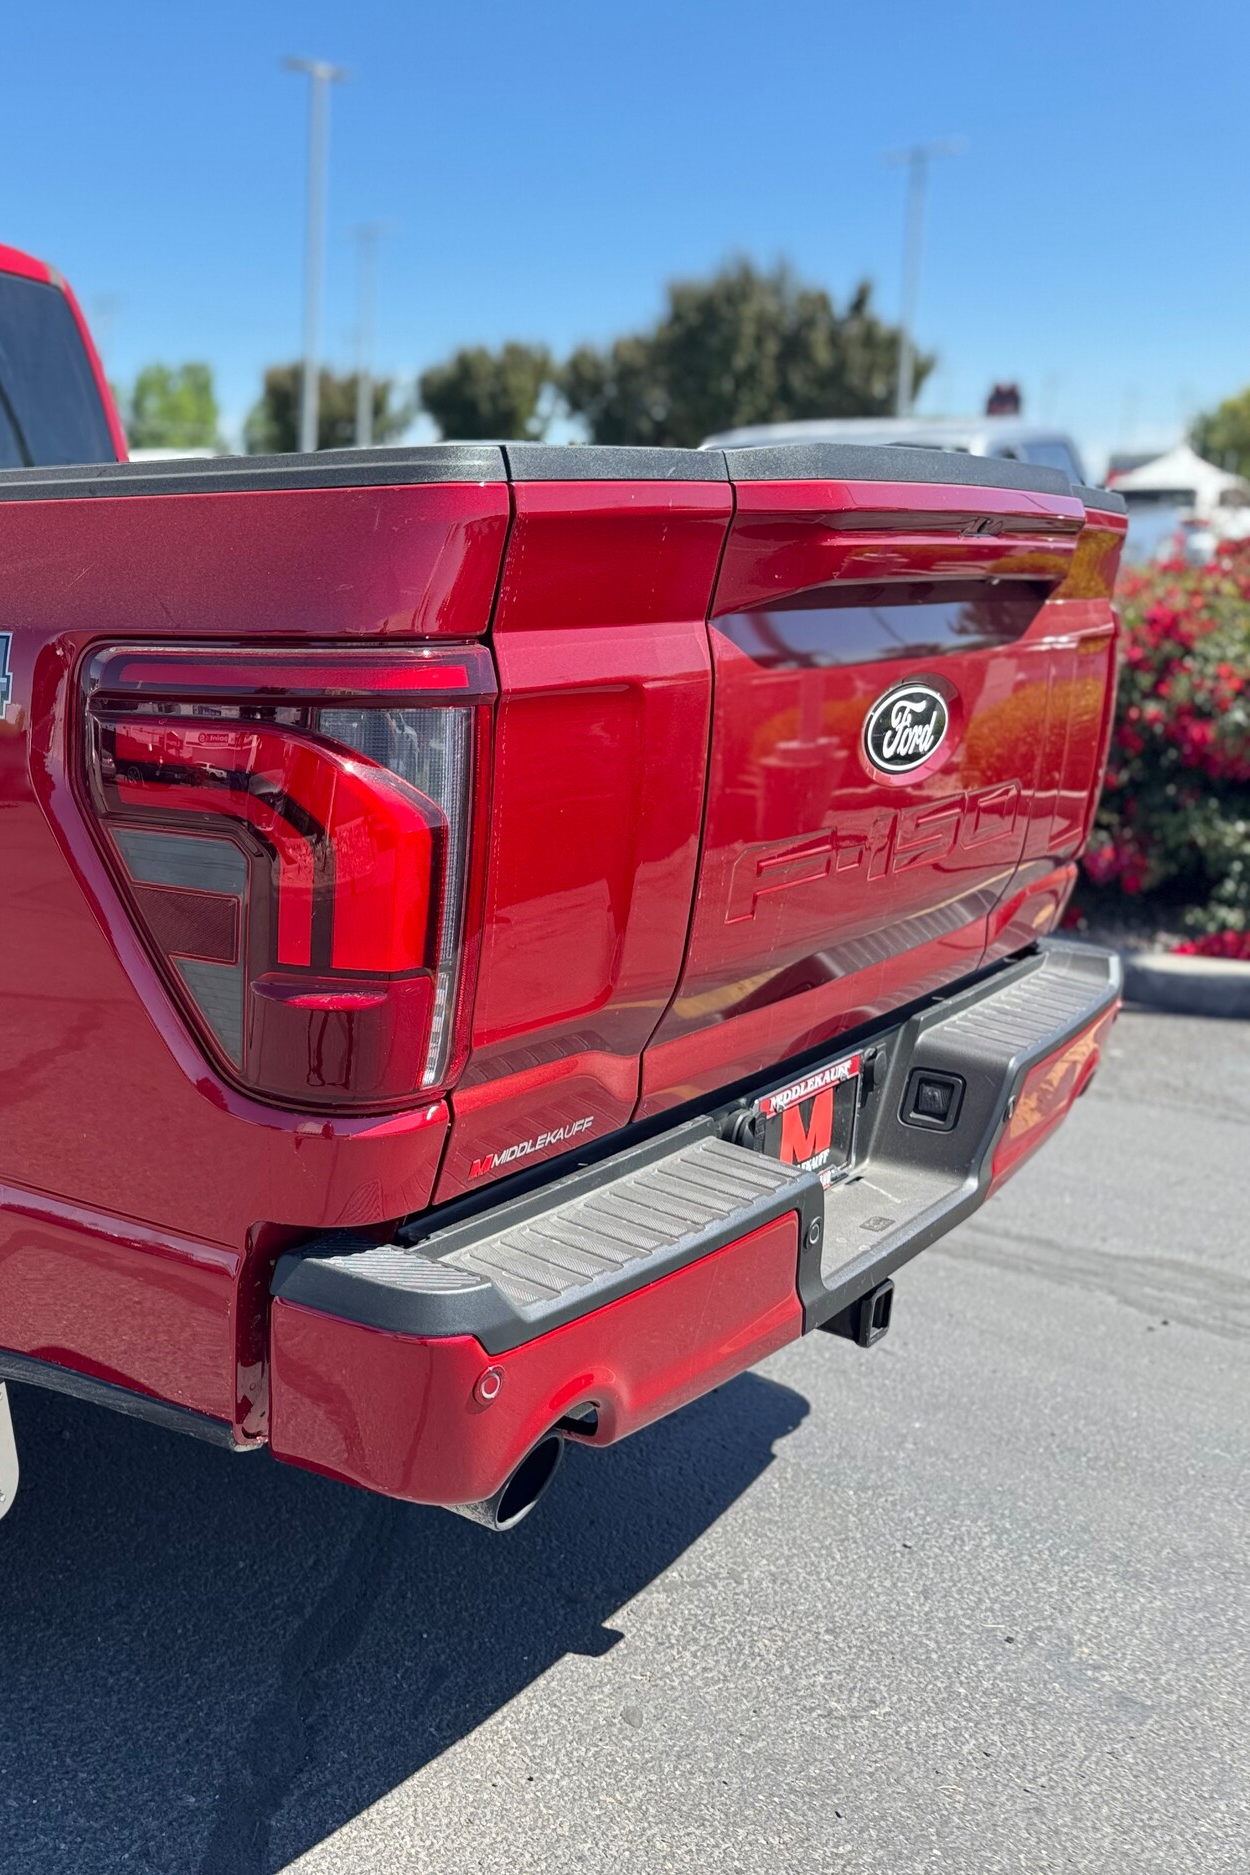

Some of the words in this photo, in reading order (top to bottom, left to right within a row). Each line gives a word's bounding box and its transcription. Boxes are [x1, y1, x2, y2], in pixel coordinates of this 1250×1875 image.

[882, 700, 938, 758] Ford
[725, 779, 1021, 925] F-150
[491, 1116, 594, 1168] MIDDLEKAUFF
